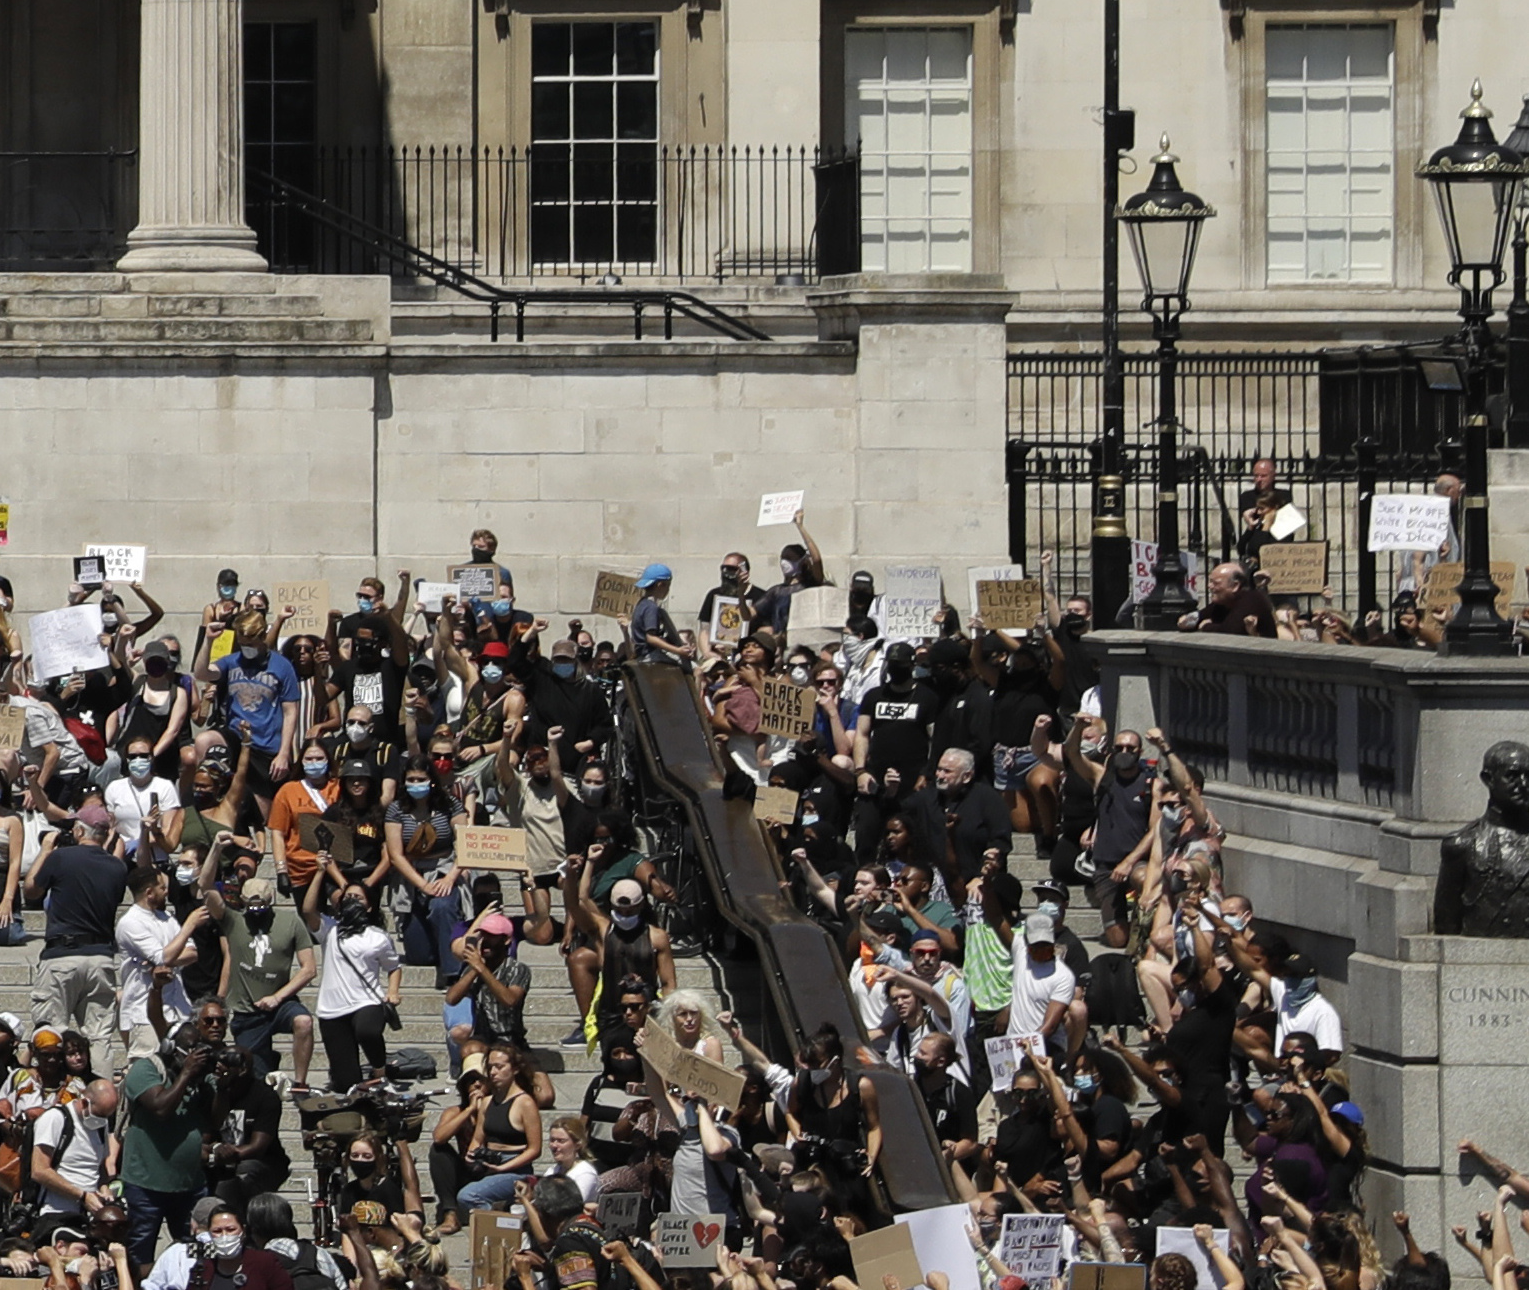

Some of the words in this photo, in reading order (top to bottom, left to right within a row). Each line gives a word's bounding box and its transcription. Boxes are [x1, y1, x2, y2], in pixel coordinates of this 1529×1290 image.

[278, 585, 319, 603] BLACK
[988, 595, 1031, 607] LIVES
[887, 605, 934, 618] BLACK
[983, 609, 1034, 623] MATTER
[889, 617, 926, 625] LIVES
[887, 624, 937, 635] MATTER
[763, 682, 803, 706] BLACK
[763, 698, 802, 718] LIVES
[761, 713, 810, 736] MATTER
[465, 833, 478, 841] NO
[480, 834, 510, 842] JUSTICE
[663, 1219, 688, 1229] BLACK
